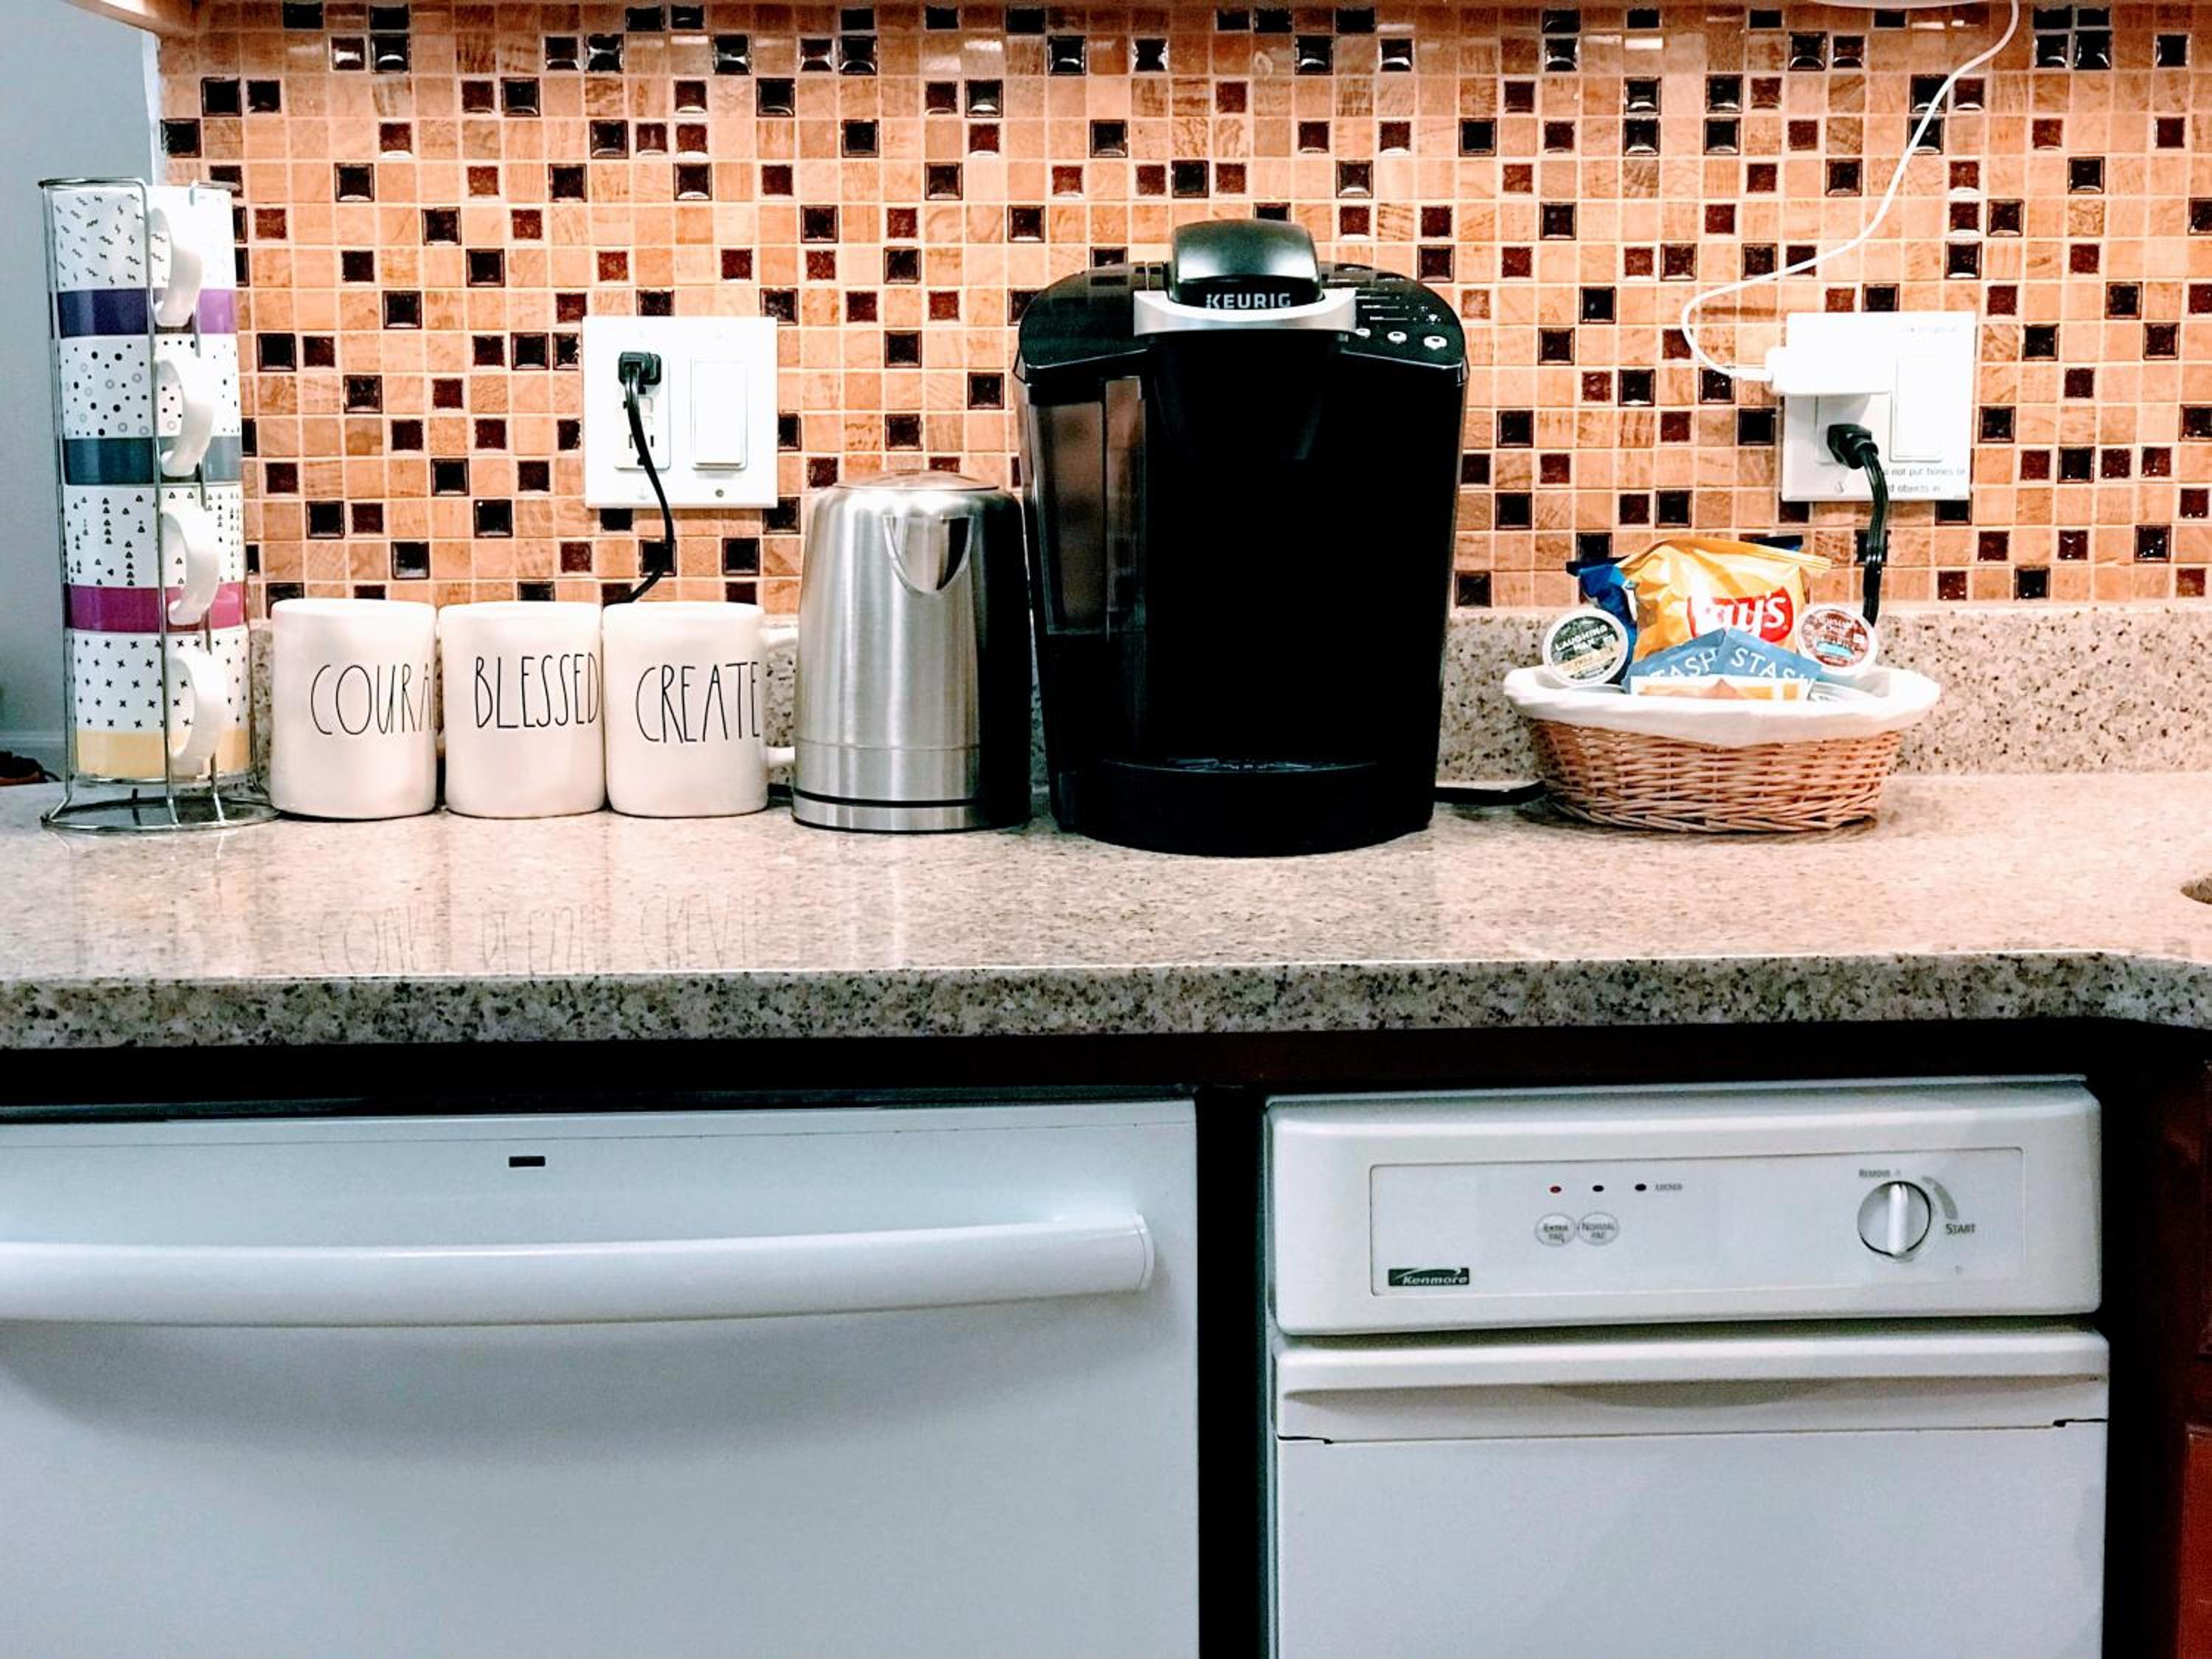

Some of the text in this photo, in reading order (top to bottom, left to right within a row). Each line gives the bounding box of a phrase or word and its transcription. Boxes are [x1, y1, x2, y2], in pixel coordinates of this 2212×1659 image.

[1206, 293, 1290, 309] KEURIG
[474, 653, 599, 728] BLESSED
[636, 661, 760, 742] CREATE
[1402, 1276, 1468, 1285] Kenmore
